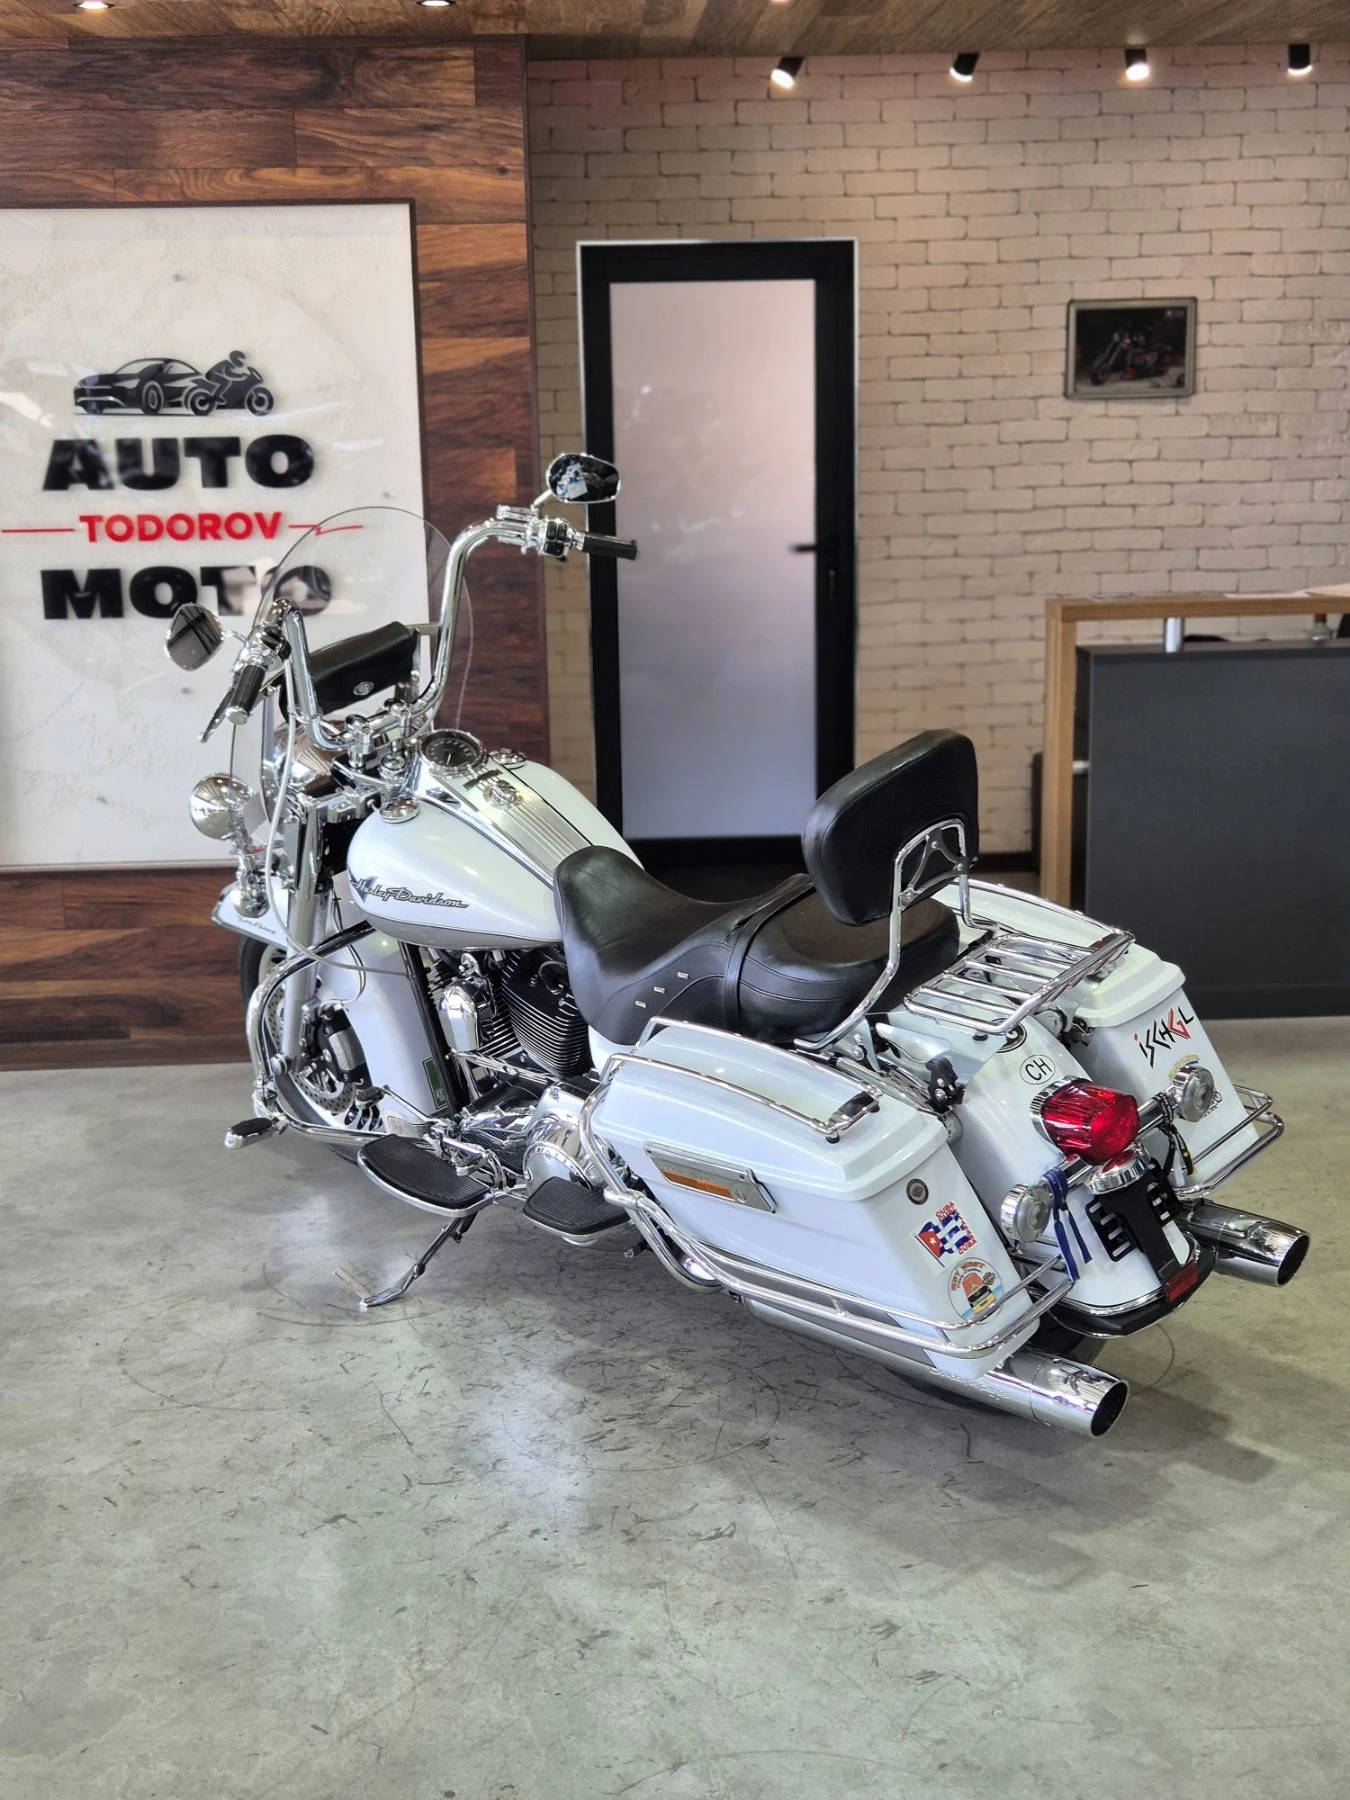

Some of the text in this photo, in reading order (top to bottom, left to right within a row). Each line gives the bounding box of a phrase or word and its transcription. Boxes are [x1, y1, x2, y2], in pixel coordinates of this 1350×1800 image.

[42, 434, 315, 490] AUTO
[79, 512, 282, 542] TODOROV
[41, 565, 333, 620] MOTO
[1025, 1058, 1052, 1081] CH
